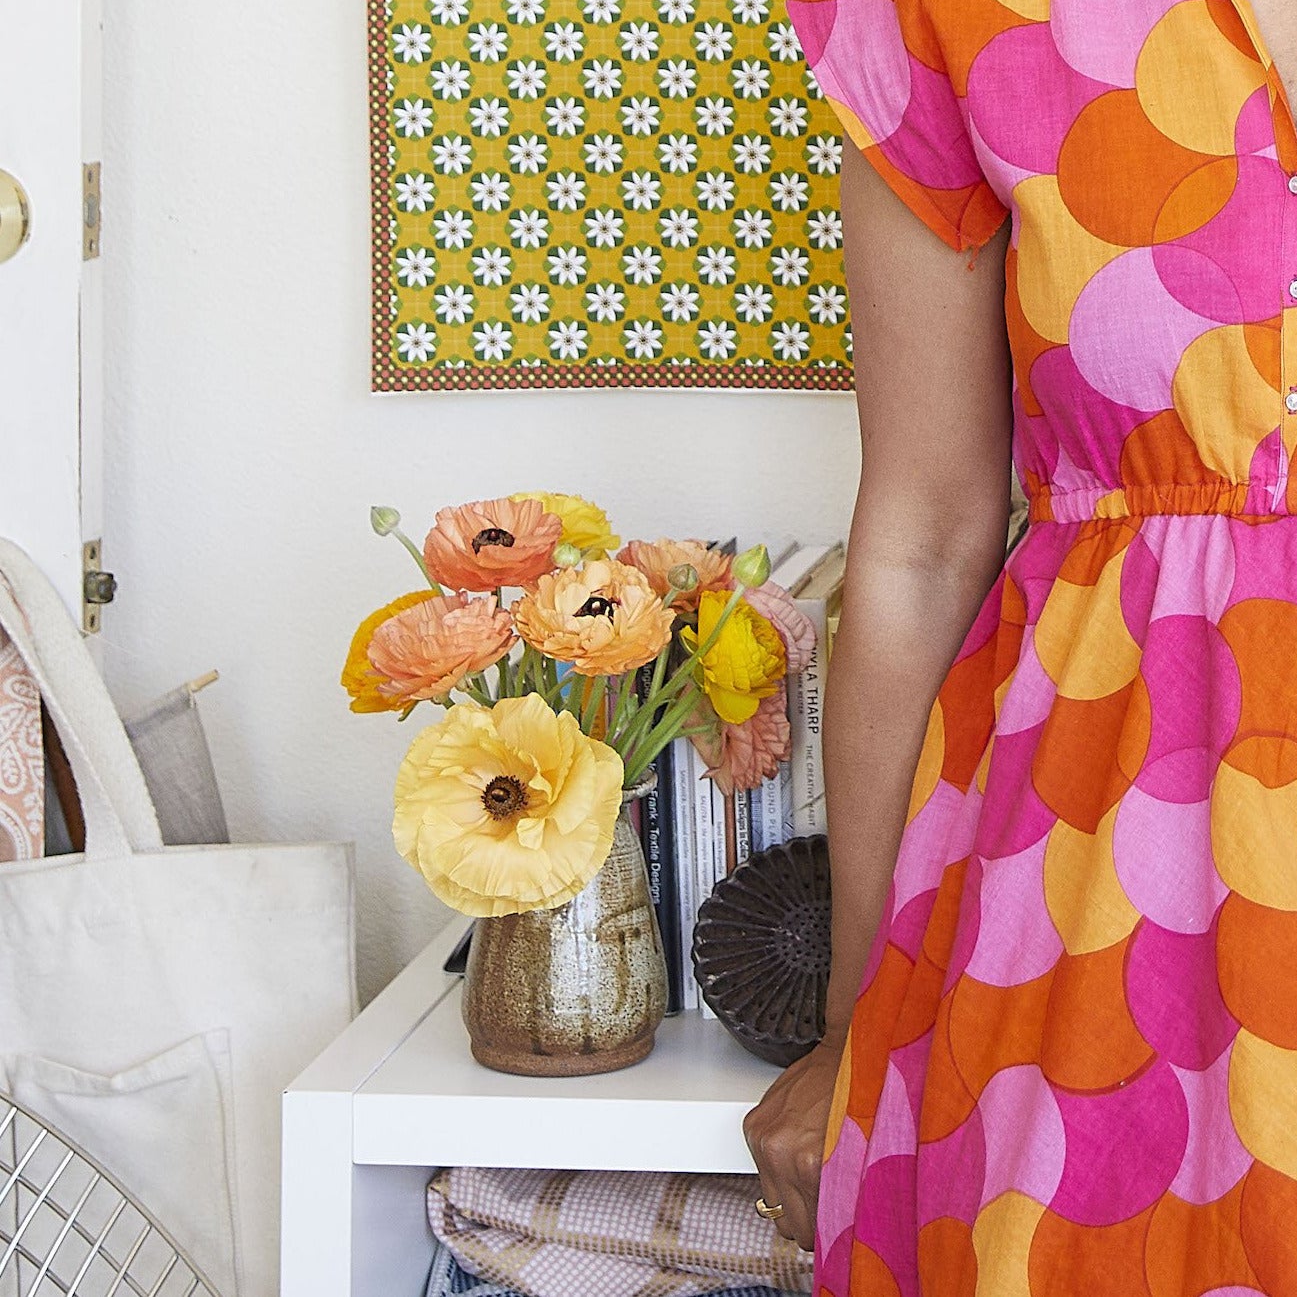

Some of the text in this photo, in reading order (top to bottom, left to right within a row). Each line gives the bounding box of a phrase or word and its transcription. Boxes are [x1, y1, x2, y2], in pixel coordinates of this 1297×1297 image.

[806, 687, 819, 735] THARP
[806, 763, 814, 799] CREATIVE
[738, 803, 747, 830] Designs
[648, 790, 661, 904] Frank Textile Designs
